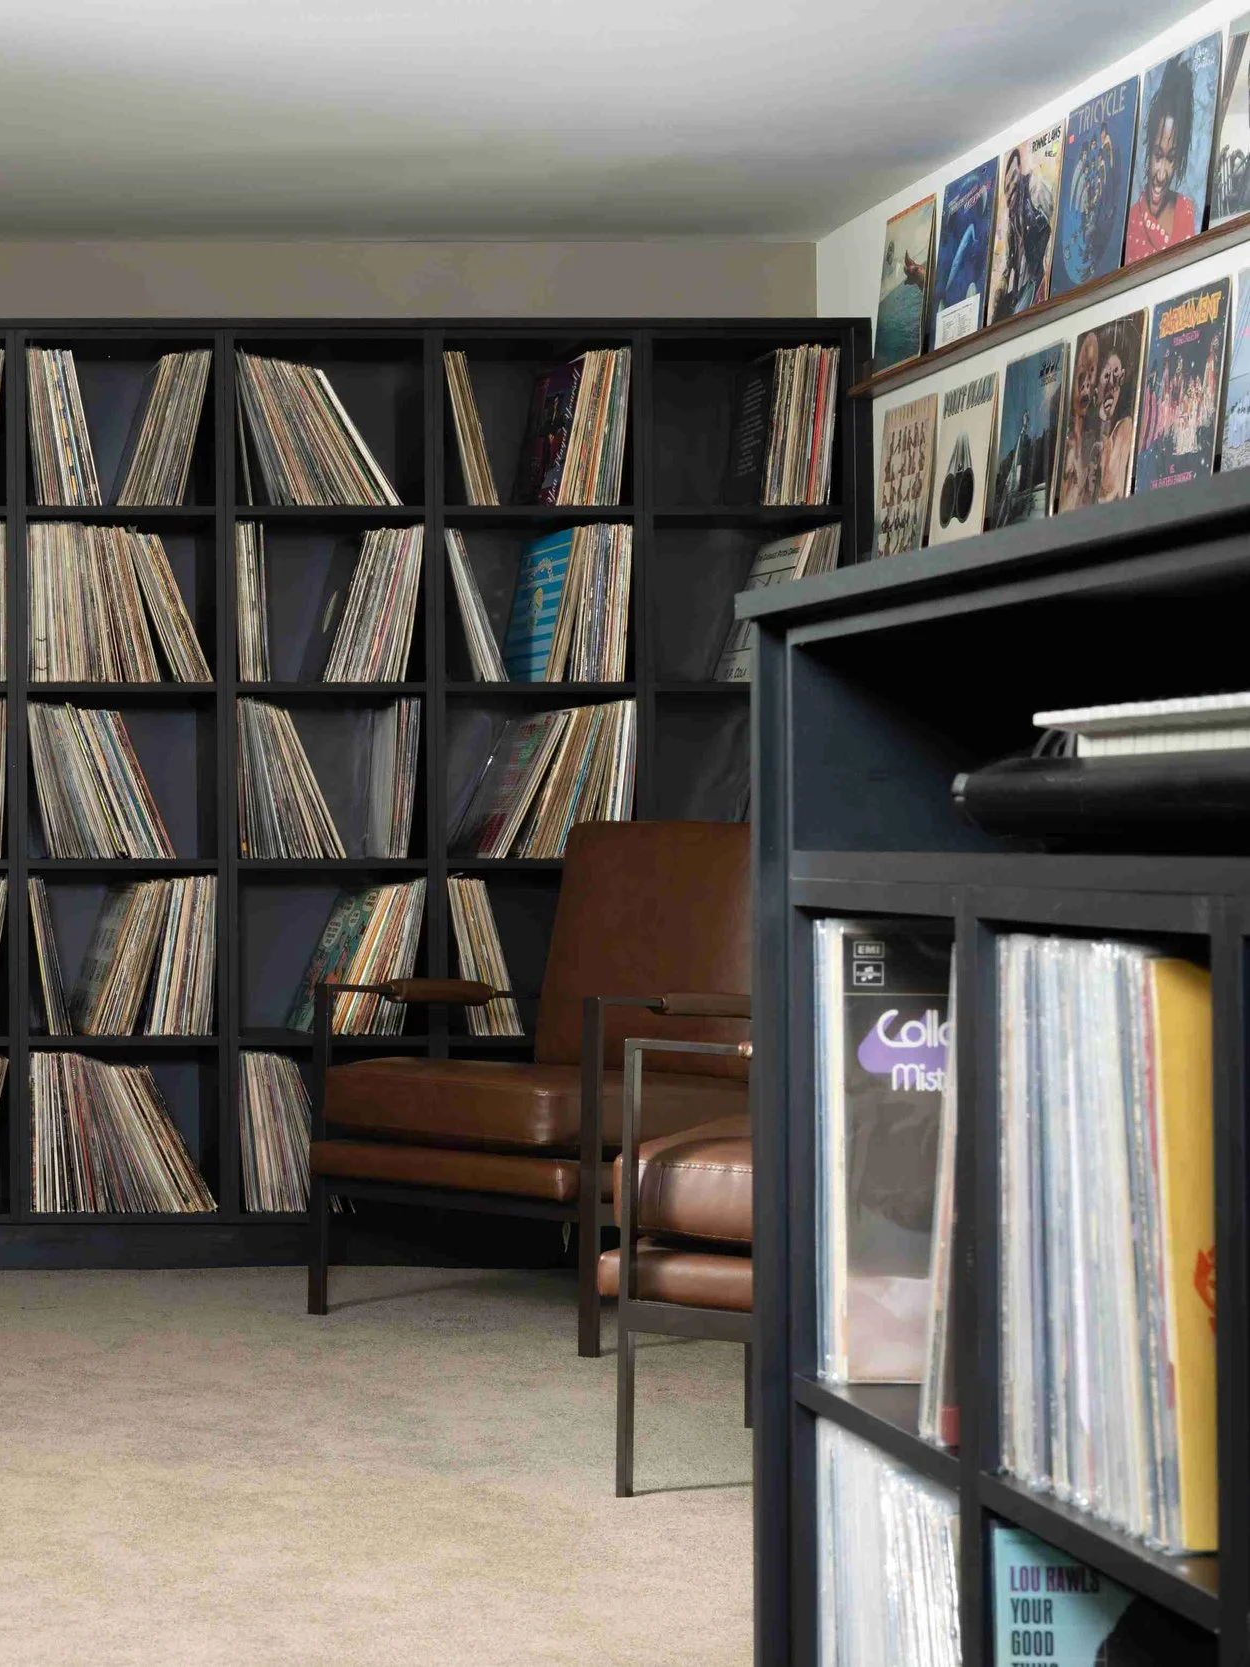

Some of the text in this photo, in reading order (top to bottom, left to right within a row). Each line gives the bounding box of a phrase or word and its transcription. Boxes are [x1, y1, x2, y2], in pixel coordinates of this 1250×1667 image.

[1078, 85, 1127, 136] TRICYCLE
[1031, 133, 1049, 153] RONNIE
[857, 945, 880, 955] EMI
[1010, 1565, 1100, 1594] LOU RAWLS
[1010, 1597, 1053, 1625] YOUR
[1011, 1630, 1055, 1657] GOOD
